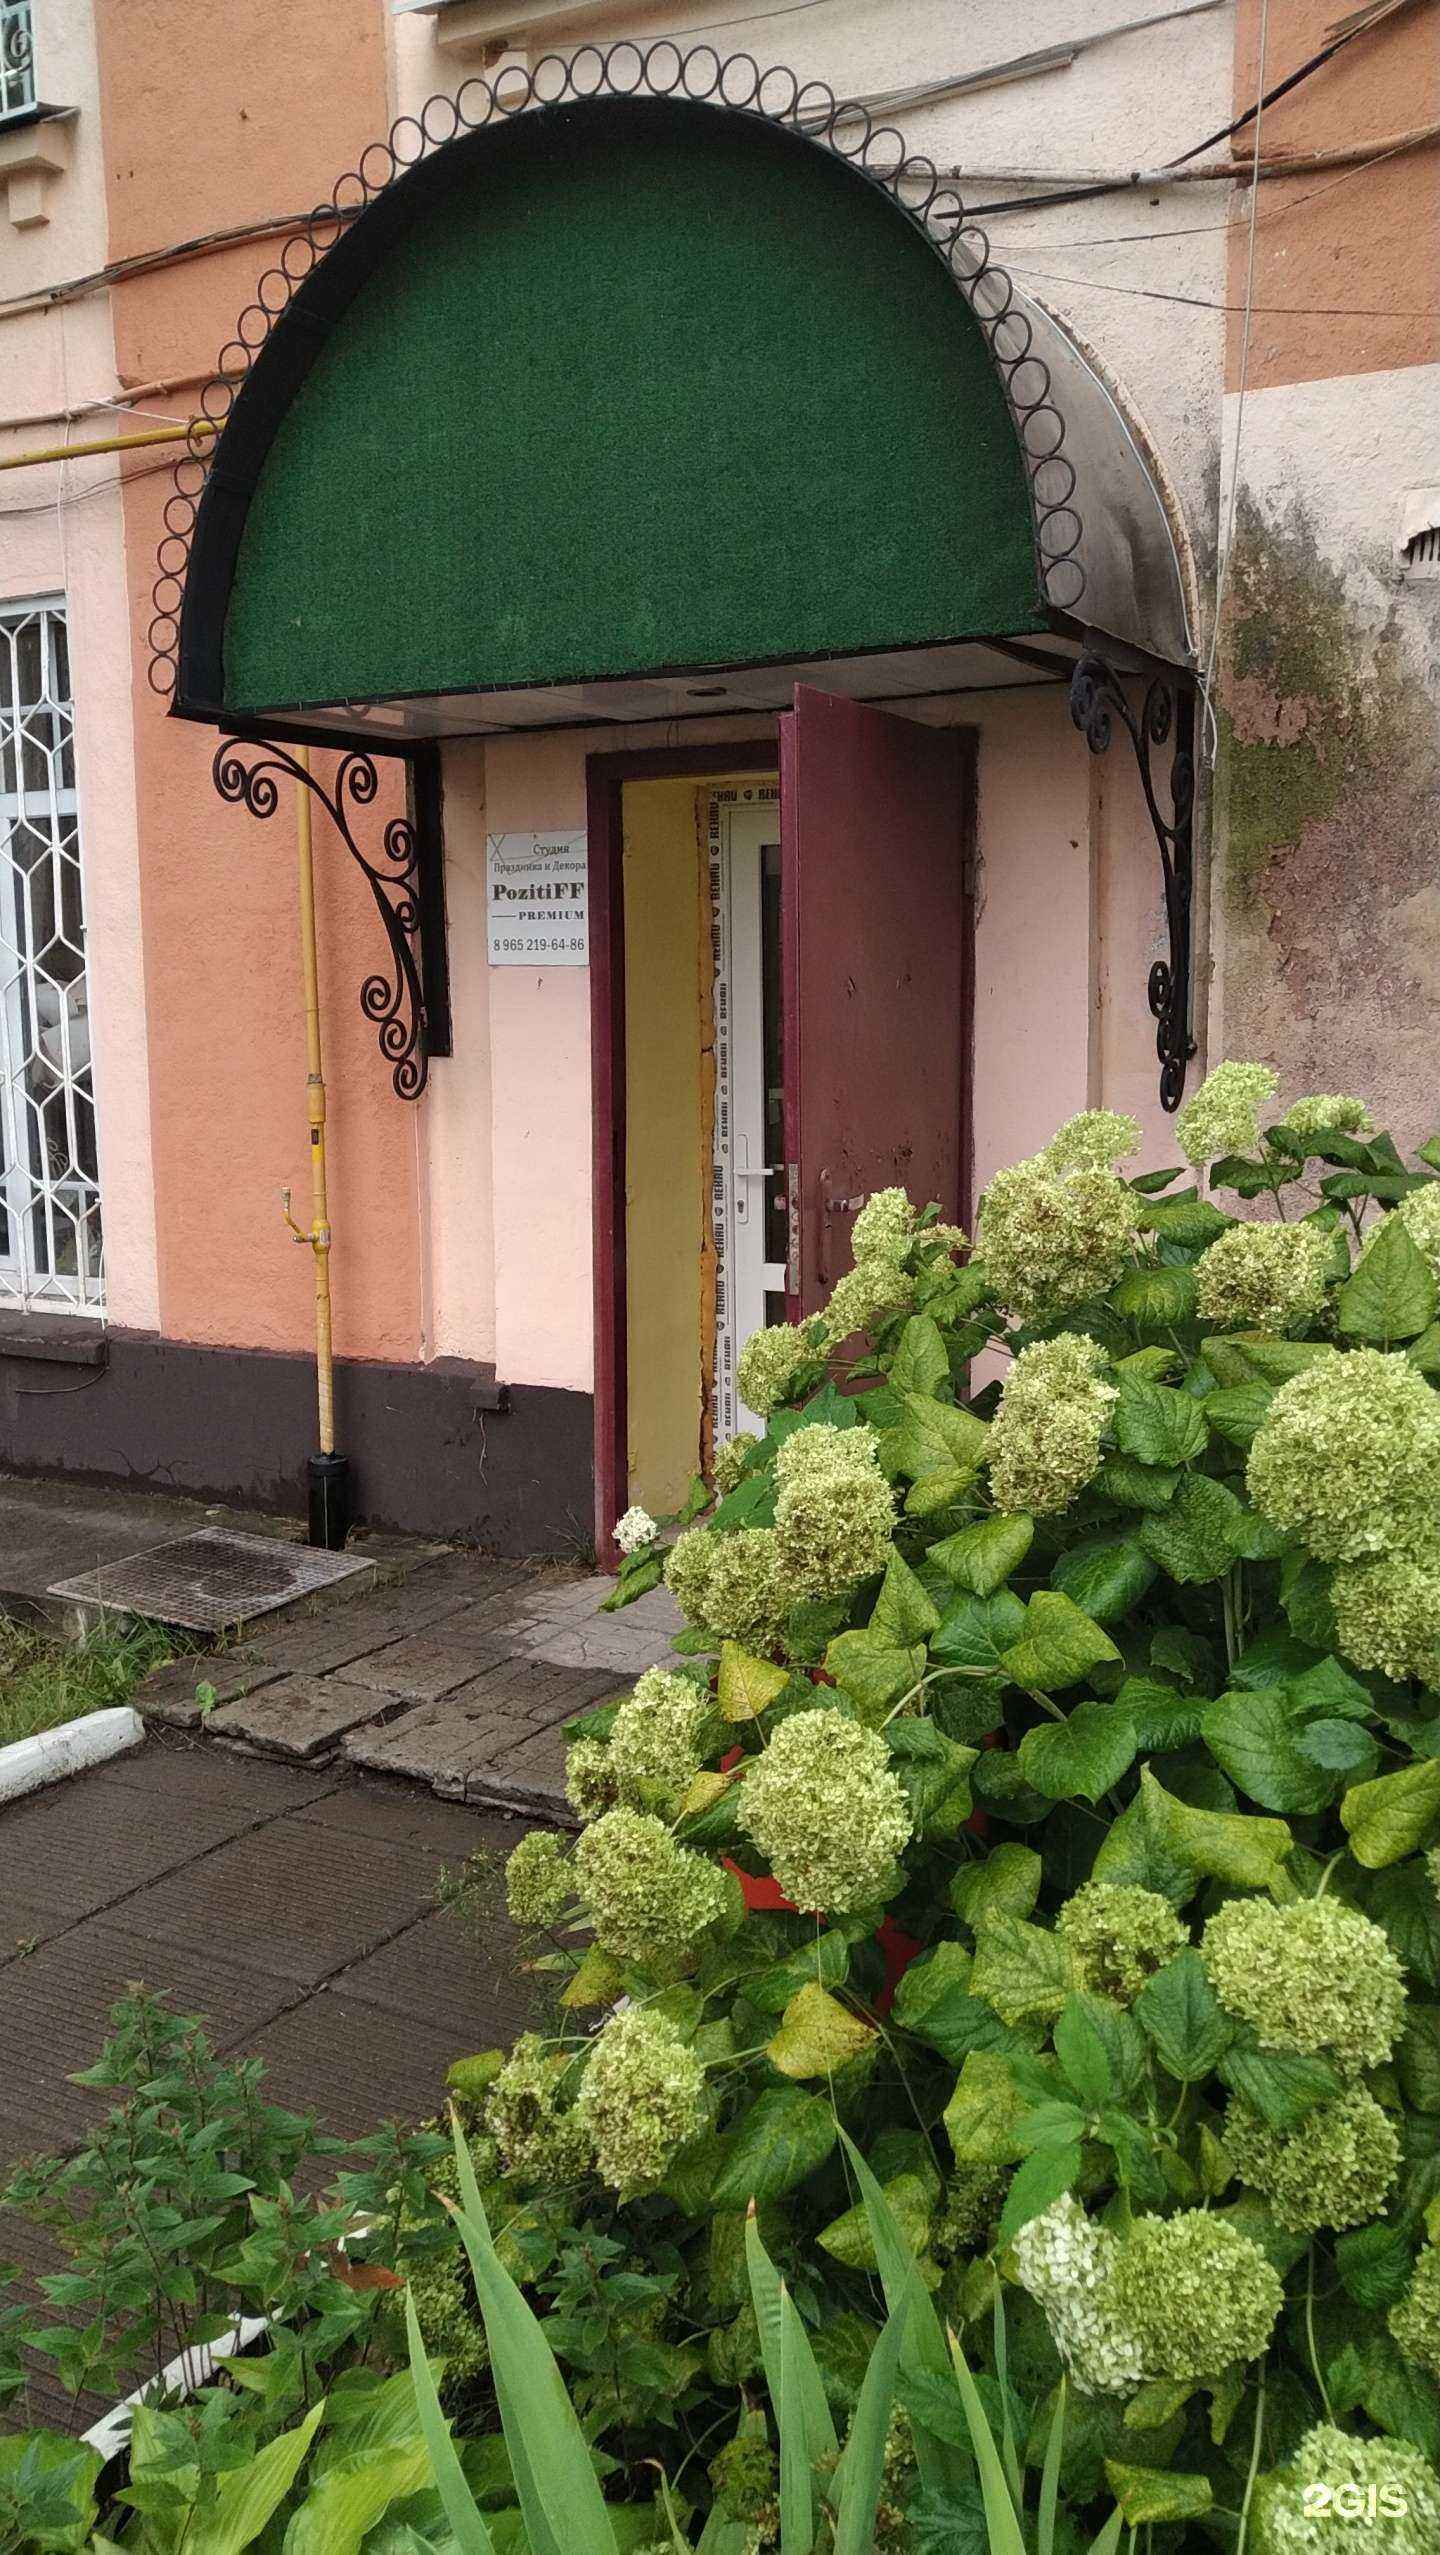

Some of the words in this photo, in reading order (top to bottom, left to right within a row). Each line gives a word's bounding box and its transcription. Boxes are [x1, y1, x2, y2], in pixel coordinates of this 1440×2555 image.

[533, 844, 570, 857] Студия
[494, 863, 543, 874] Праздника
[552, 860, 586, 873] Декора
[492, 881, 585, 901] PozitiFF
[518, 910, 585, 921] PREMIUM
[493, 938, 501, 951] 8
[503, 938, 524, 951] 965
[526, 938, 585, 951] 219-64-86
[714, 1165, 724, 1201] REHAU
